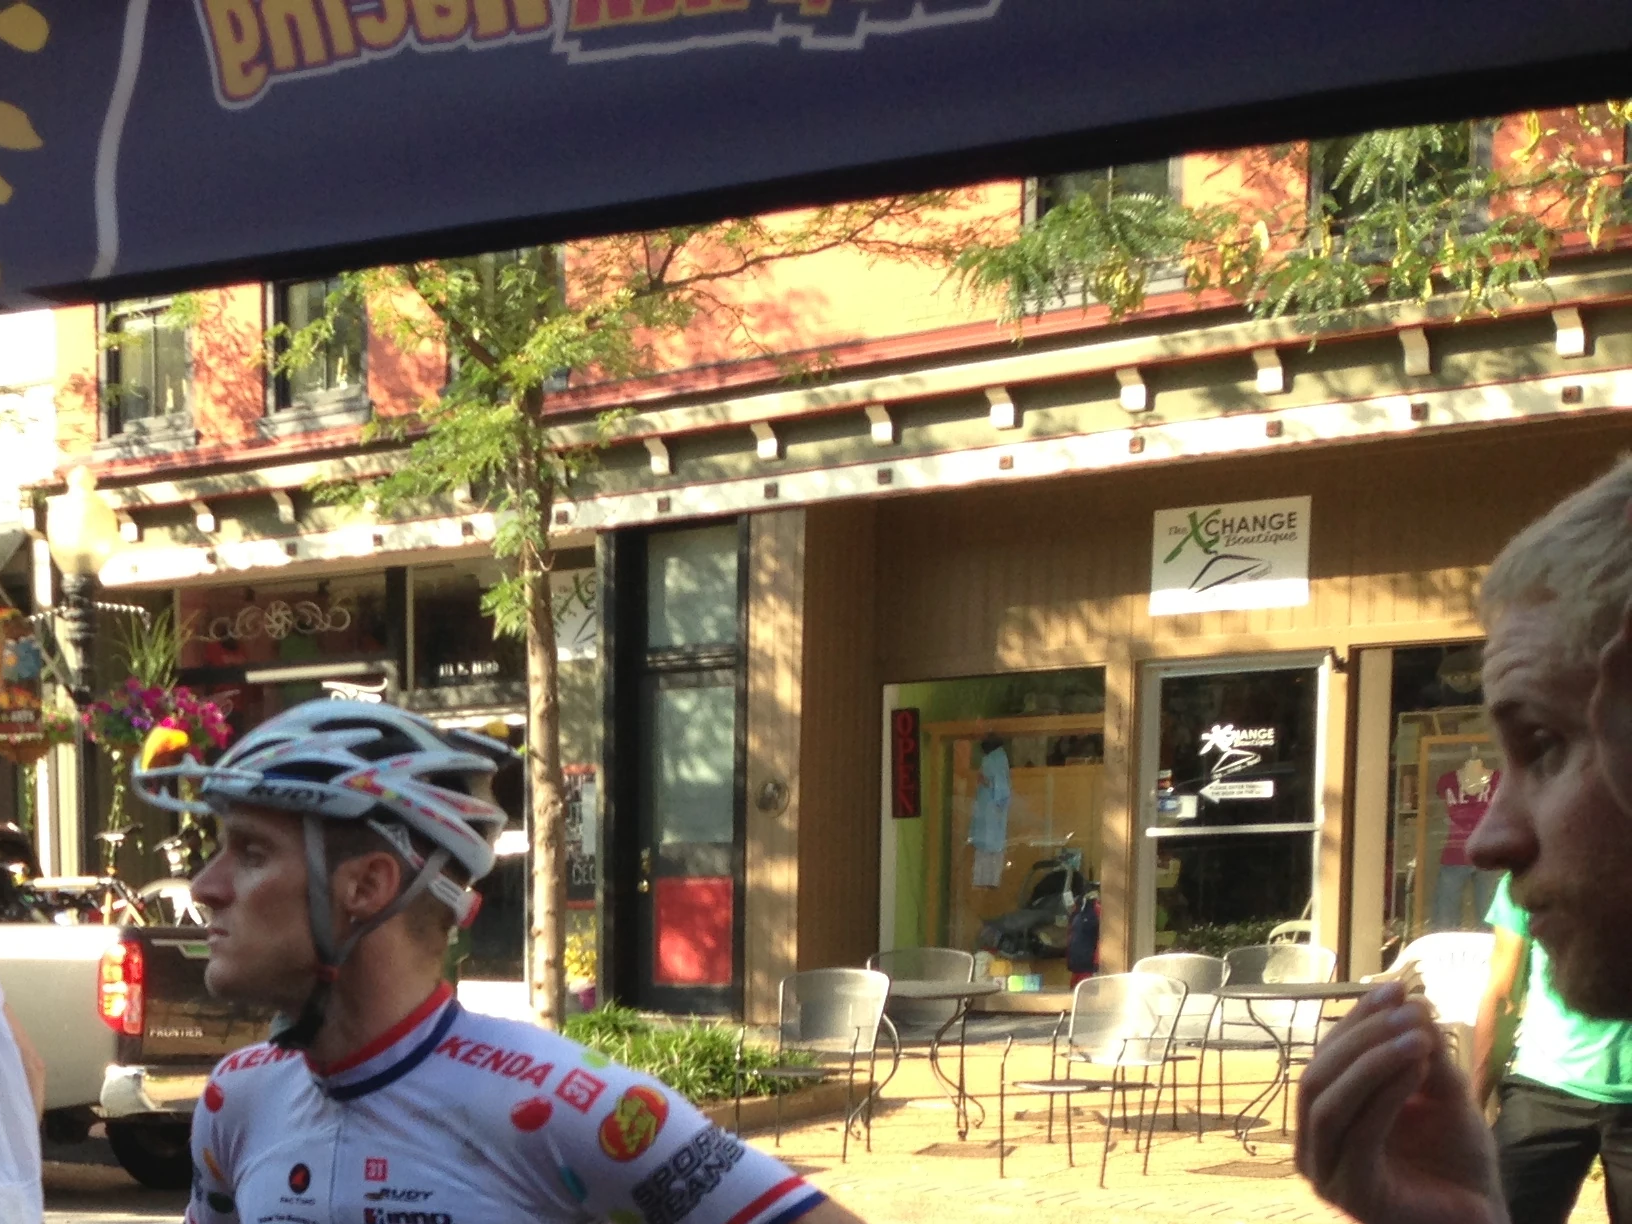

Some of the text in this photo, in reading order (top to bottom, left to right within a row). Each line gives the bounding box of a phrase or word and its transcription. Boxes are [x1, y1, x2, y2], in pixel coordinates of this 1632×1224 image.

[1223, 531, 1298, 548] Boutique
[896, 710, 917, 814] OPEN
[434, 1035, 555, 1089] KENDA
